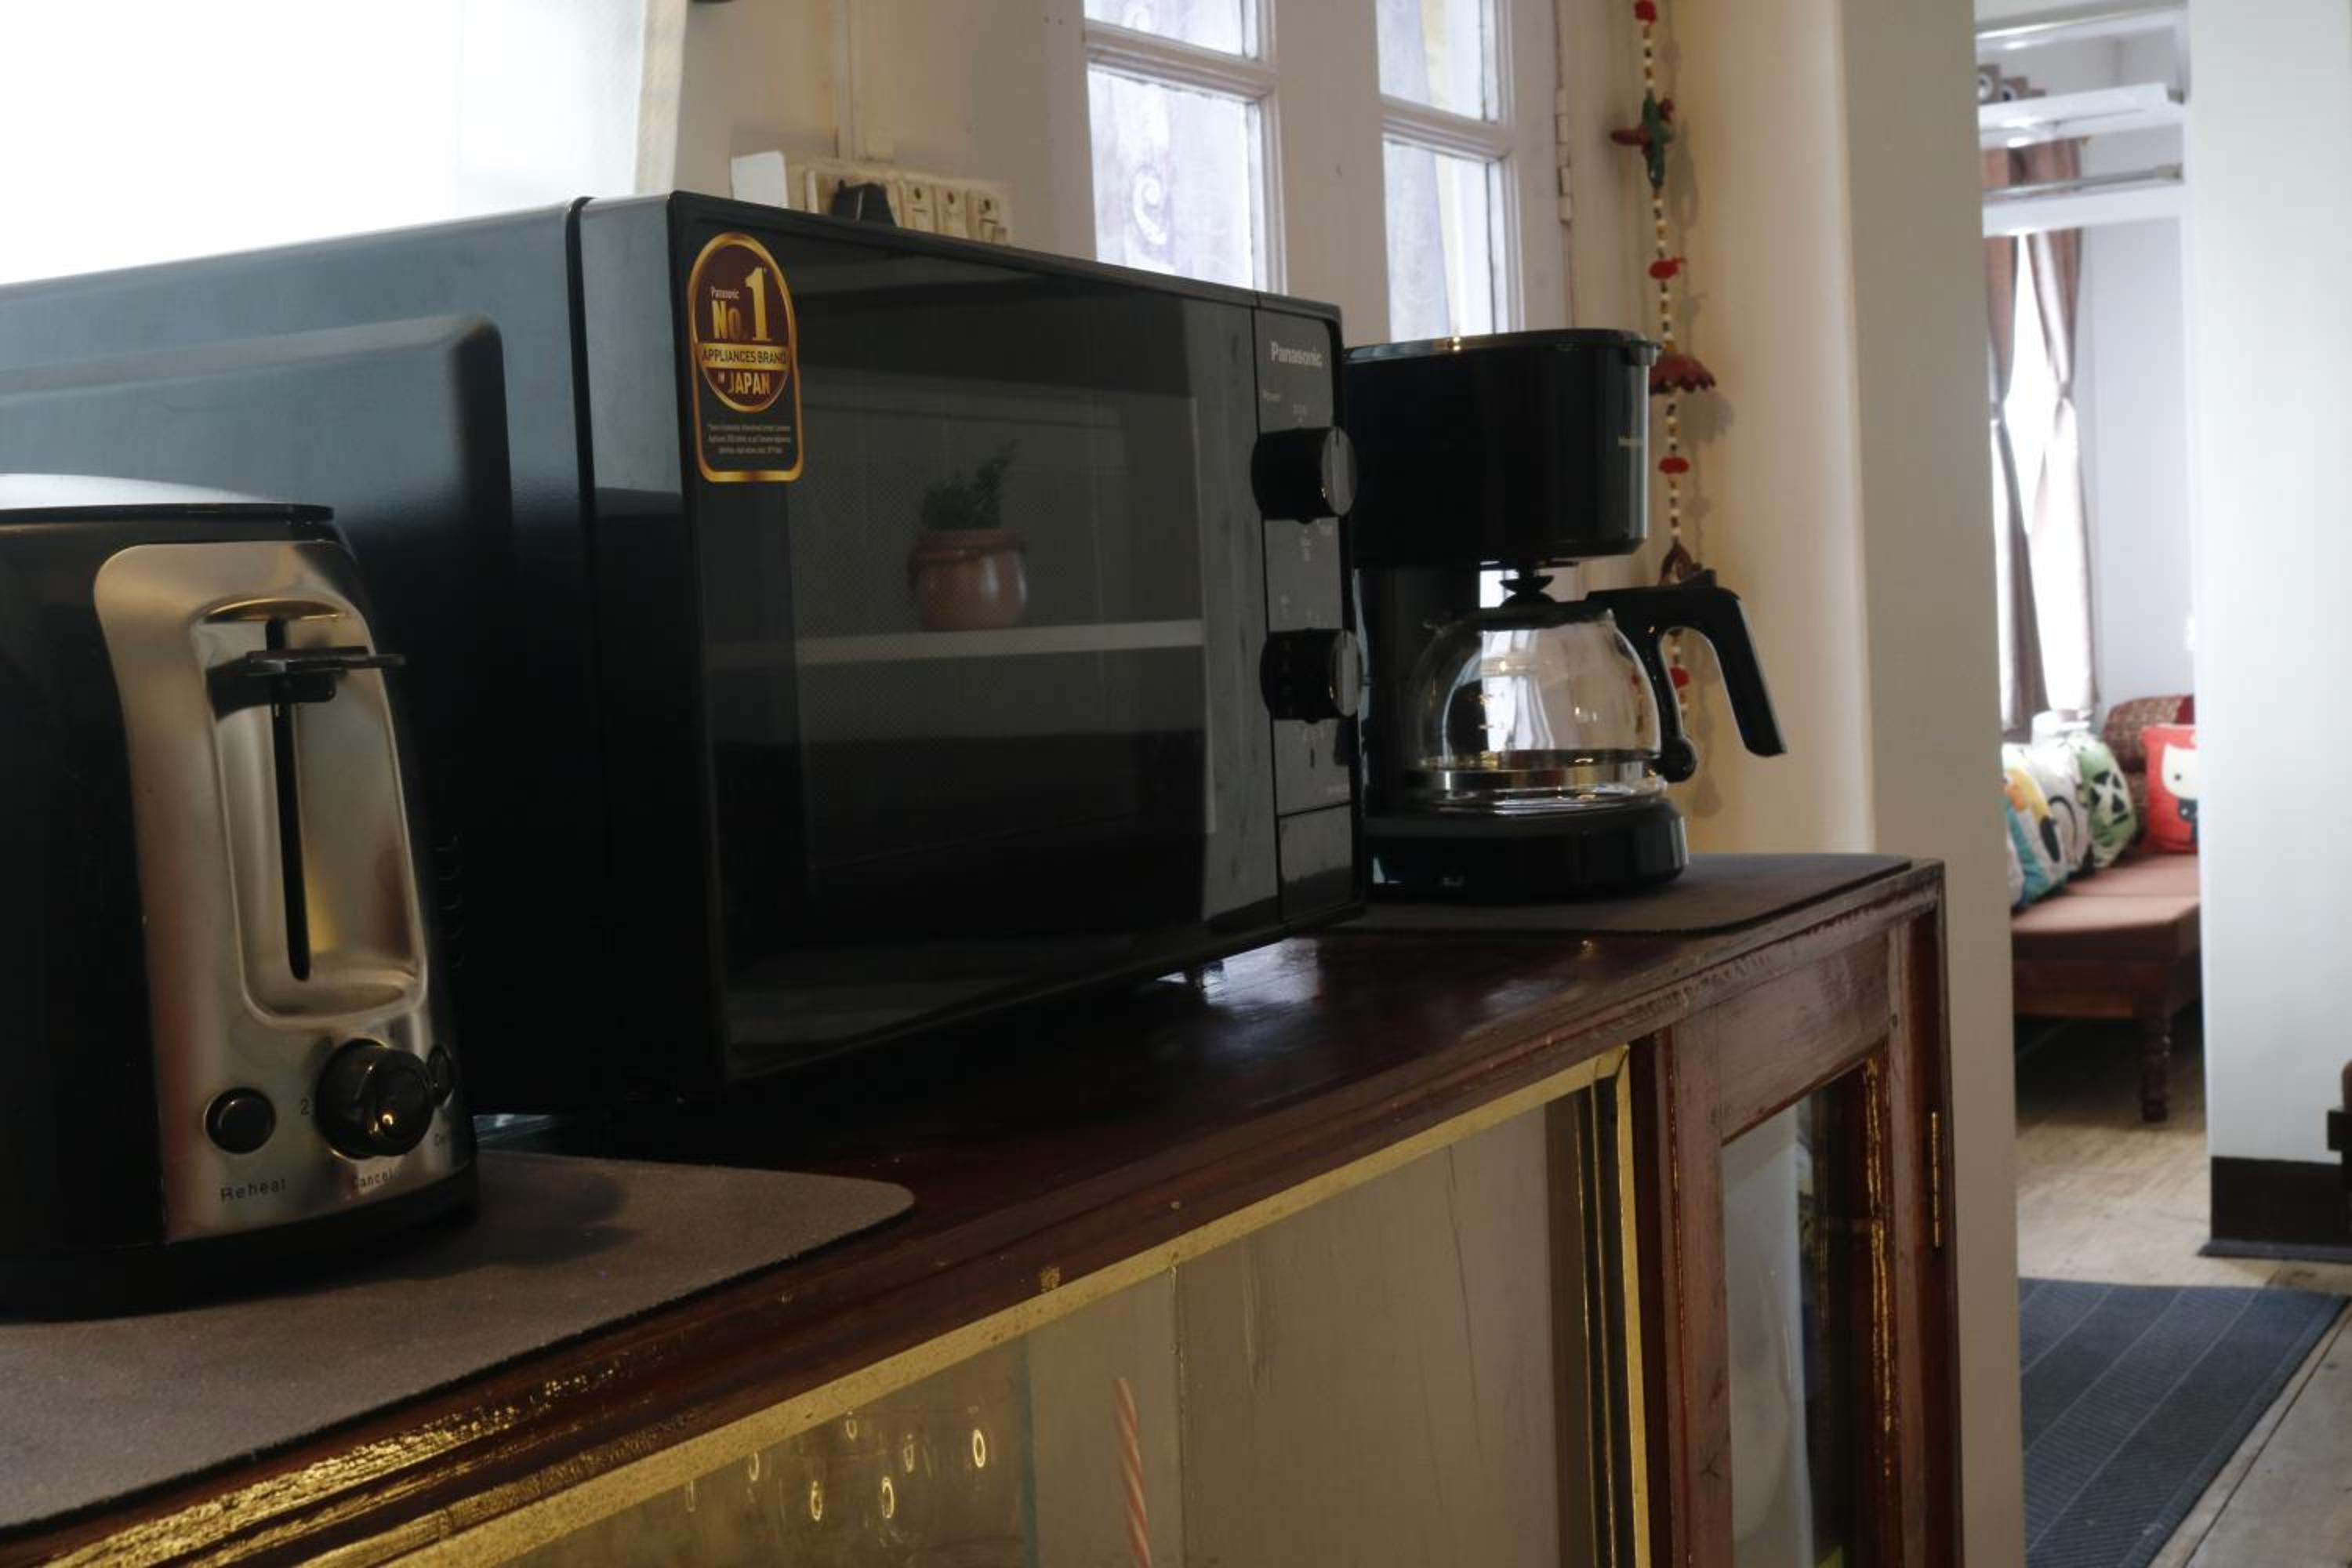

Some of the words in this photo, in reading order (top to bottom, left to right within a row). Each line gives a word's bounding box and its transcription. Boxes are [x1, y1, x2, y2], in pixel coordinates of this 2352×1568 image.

[703, 348, 757, 363] APPLIANCES
[757, 351, 787, 364] BRAND
[1271, 341, 1323, 367] Panasonic
[728, 372, 771, 394] JAPAN
[300, 1098, 310, 1116] 2
